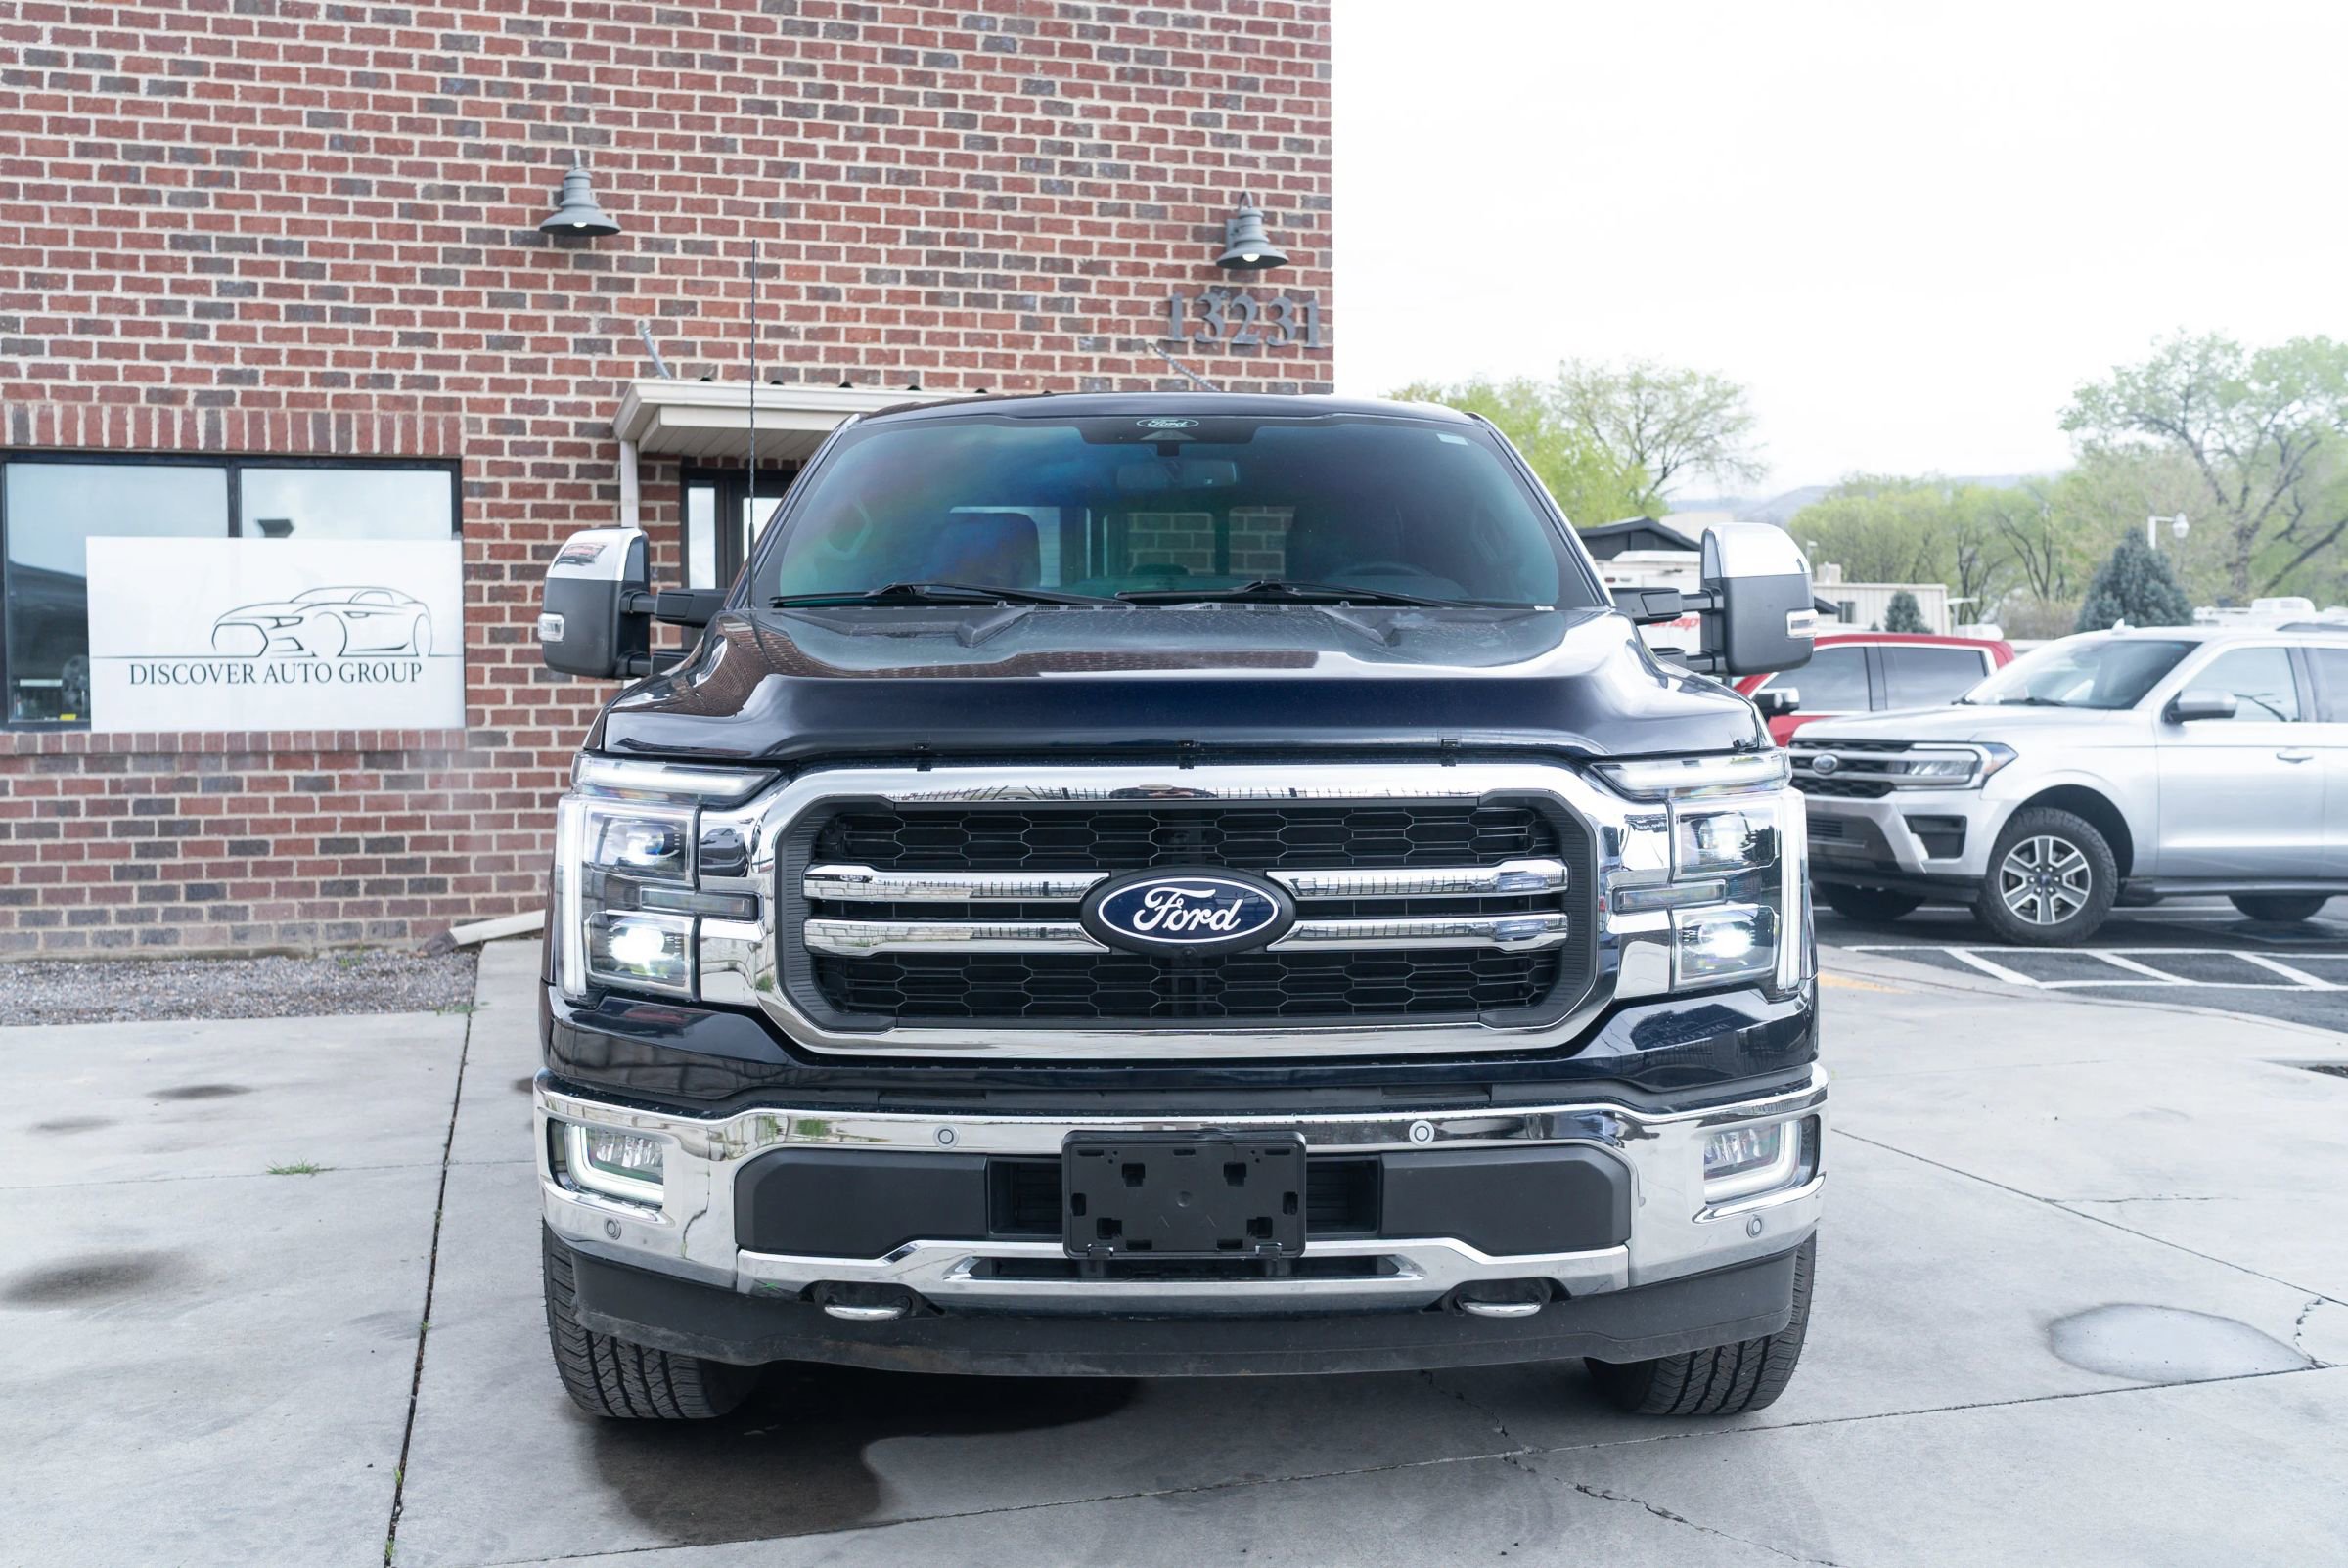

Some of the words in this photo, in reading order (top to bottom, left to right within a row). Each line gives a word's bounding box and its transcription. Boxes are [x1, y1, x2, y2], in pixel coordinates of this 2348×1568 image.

[1169, 291, 1324, 348] 13231
[1147, 419, 1189, 427] Ford
[130, 663, 256, 685] DISCOVER
[263, 662, 332, 684] AUTO
[339, 662, 422, 684] GROUP
[1133, 886, 1243, 931] Ford
